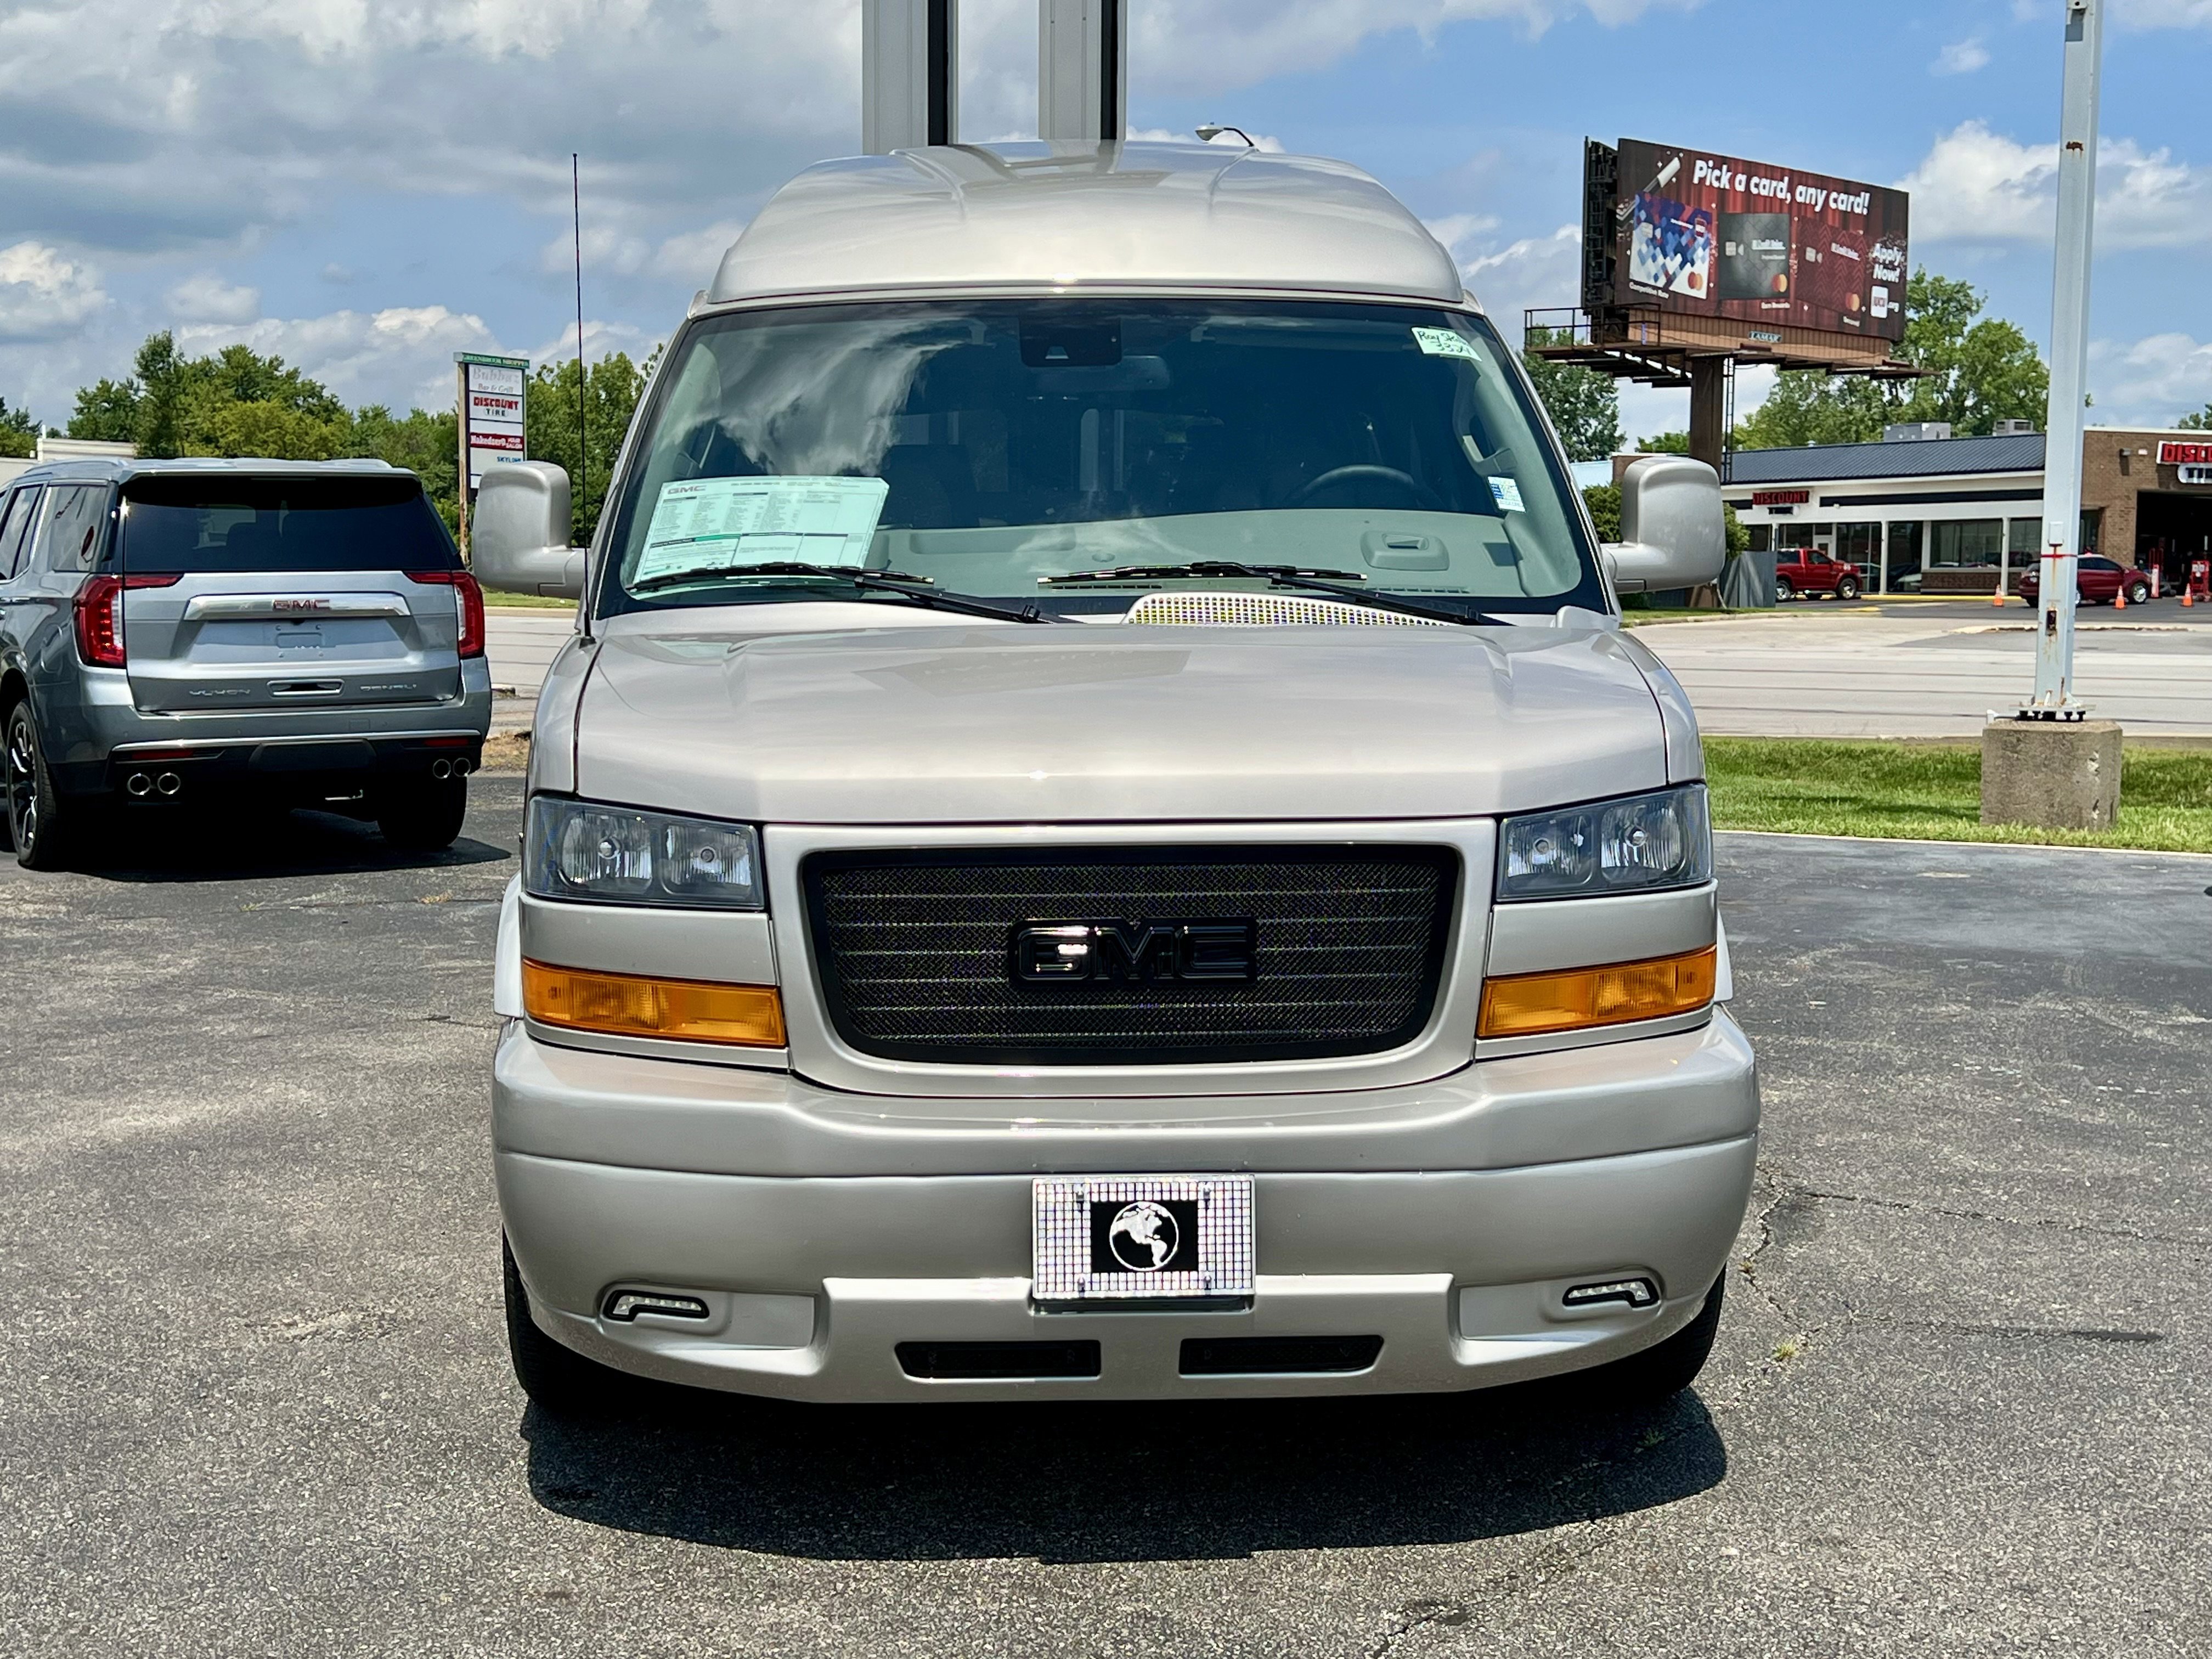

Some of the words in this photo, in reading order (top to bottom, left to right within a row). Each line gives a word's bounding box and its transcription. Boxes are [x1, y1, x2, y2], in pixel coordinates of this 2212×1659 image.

[1692, 160, 1733, 189] Pick
[1734, 173, 1747, 192] a
[1750, 176, 1791, 204] card,
[1795, 184, 1827, 212] any
[1829, 191, 1871, 215] card!
[1872, 243, 1903, 266] Apply
[1872, 263, 1900, 283] Now!
[473, 396, 519, 410] DISCOUNT
[486, 408, 506, 417] TIRE
[2163, 445, 2212, 462] DISC
[668, 485, 707, 494] GMC
[1753, 492, 1807, 504] DISCOUNT
[273, 599, 330, 611] GMC
[1016, 924, 1251, 982] GMC
